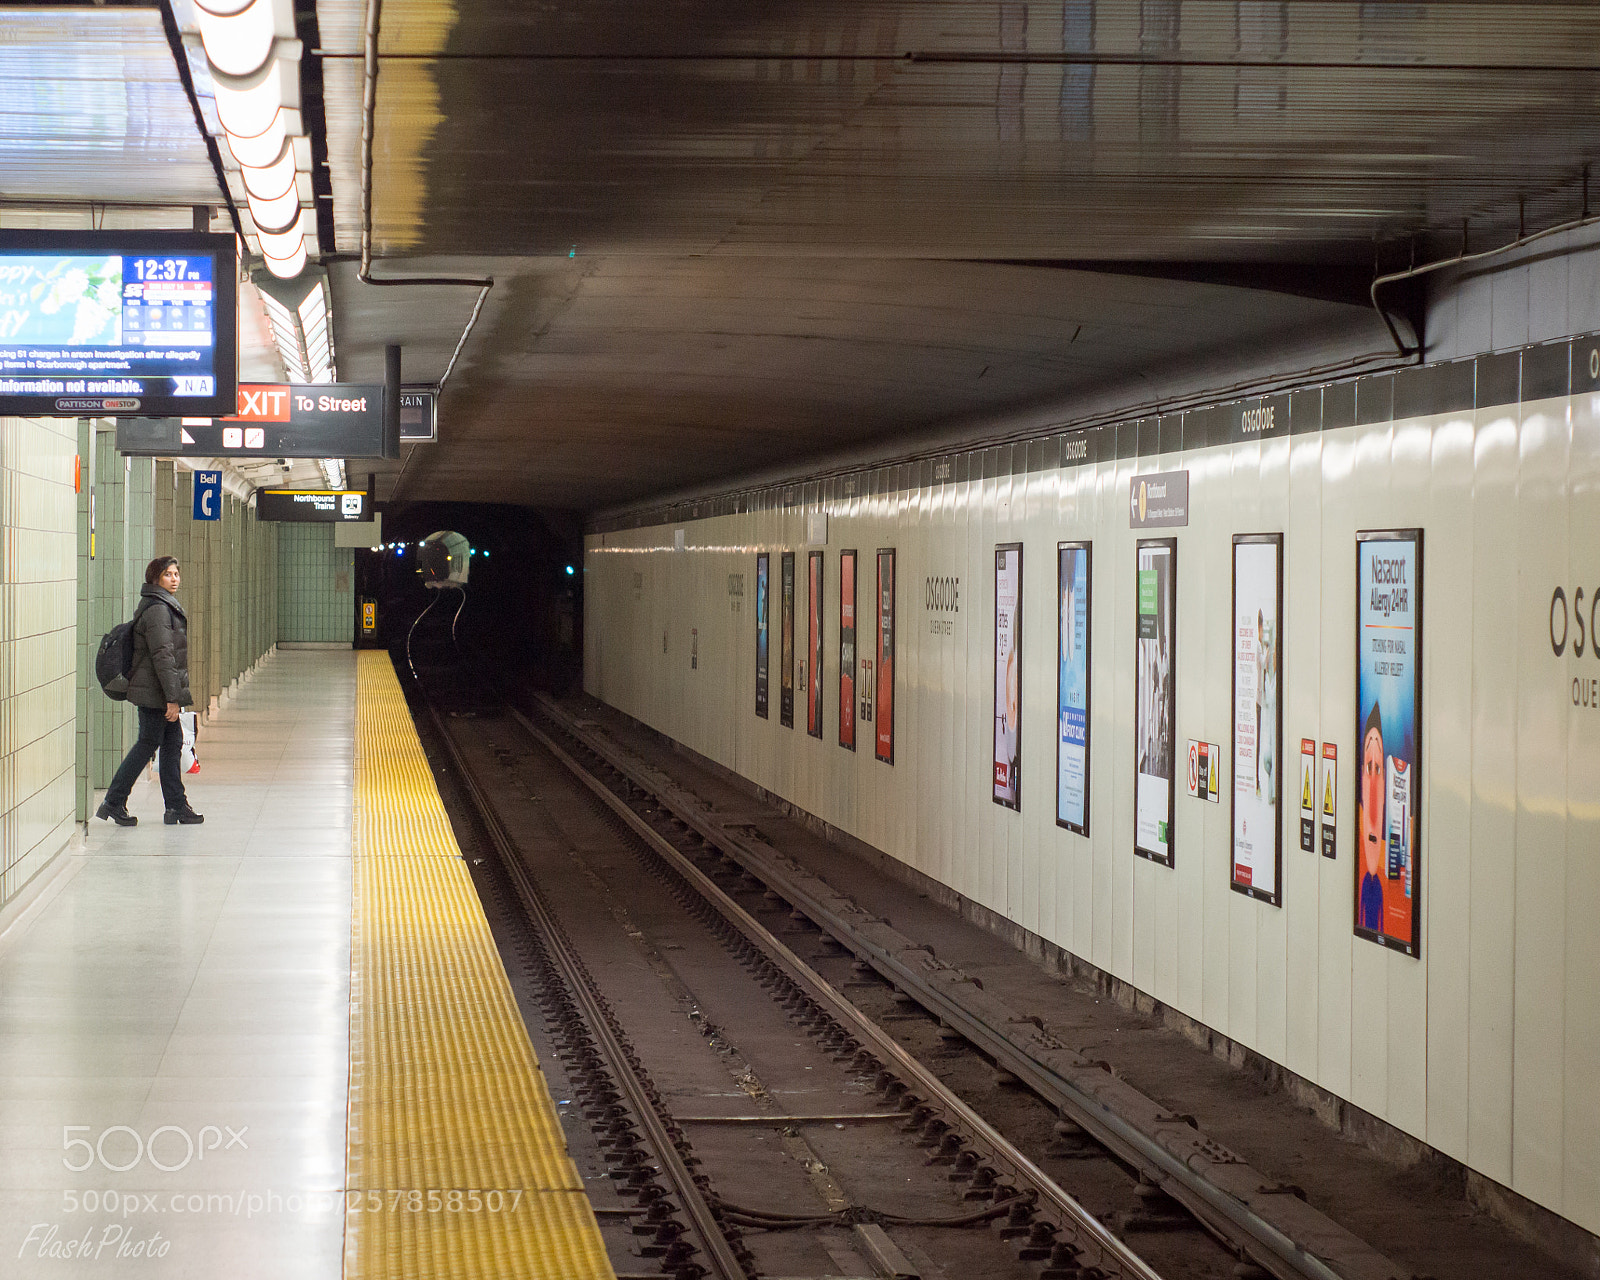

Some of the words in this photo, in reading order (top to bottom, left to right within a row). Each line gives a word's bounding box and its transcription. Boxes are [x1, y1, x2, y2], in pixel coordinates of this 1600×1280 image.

[134, 260, 187, 280] 12:37
[28, 350, 60, 360] charges
[94, 350, 144, 360] investigation
[165, 350, 201, 360] allegedly
[36, 361, 87, 371] Scarborough
[66, 380, 86, 393] not
[87, 379, 143, 393] available.
[238, 391, 287, 416] XIT
[294, 395, 315, 412] To
[318, 395, 367, 412] Street
[1241, 406, 1275, 433] OSGOODE
[200, 473, 217, 484] Bell
[293, 495, 336, 503] Northbound
[314, 502, 336, 510] Trains
[1371, 555, 1406, 585] Nasacort
[926, 576, 959, 613] OSGOODE
[1370, 588, 1391, 618] Allergy
